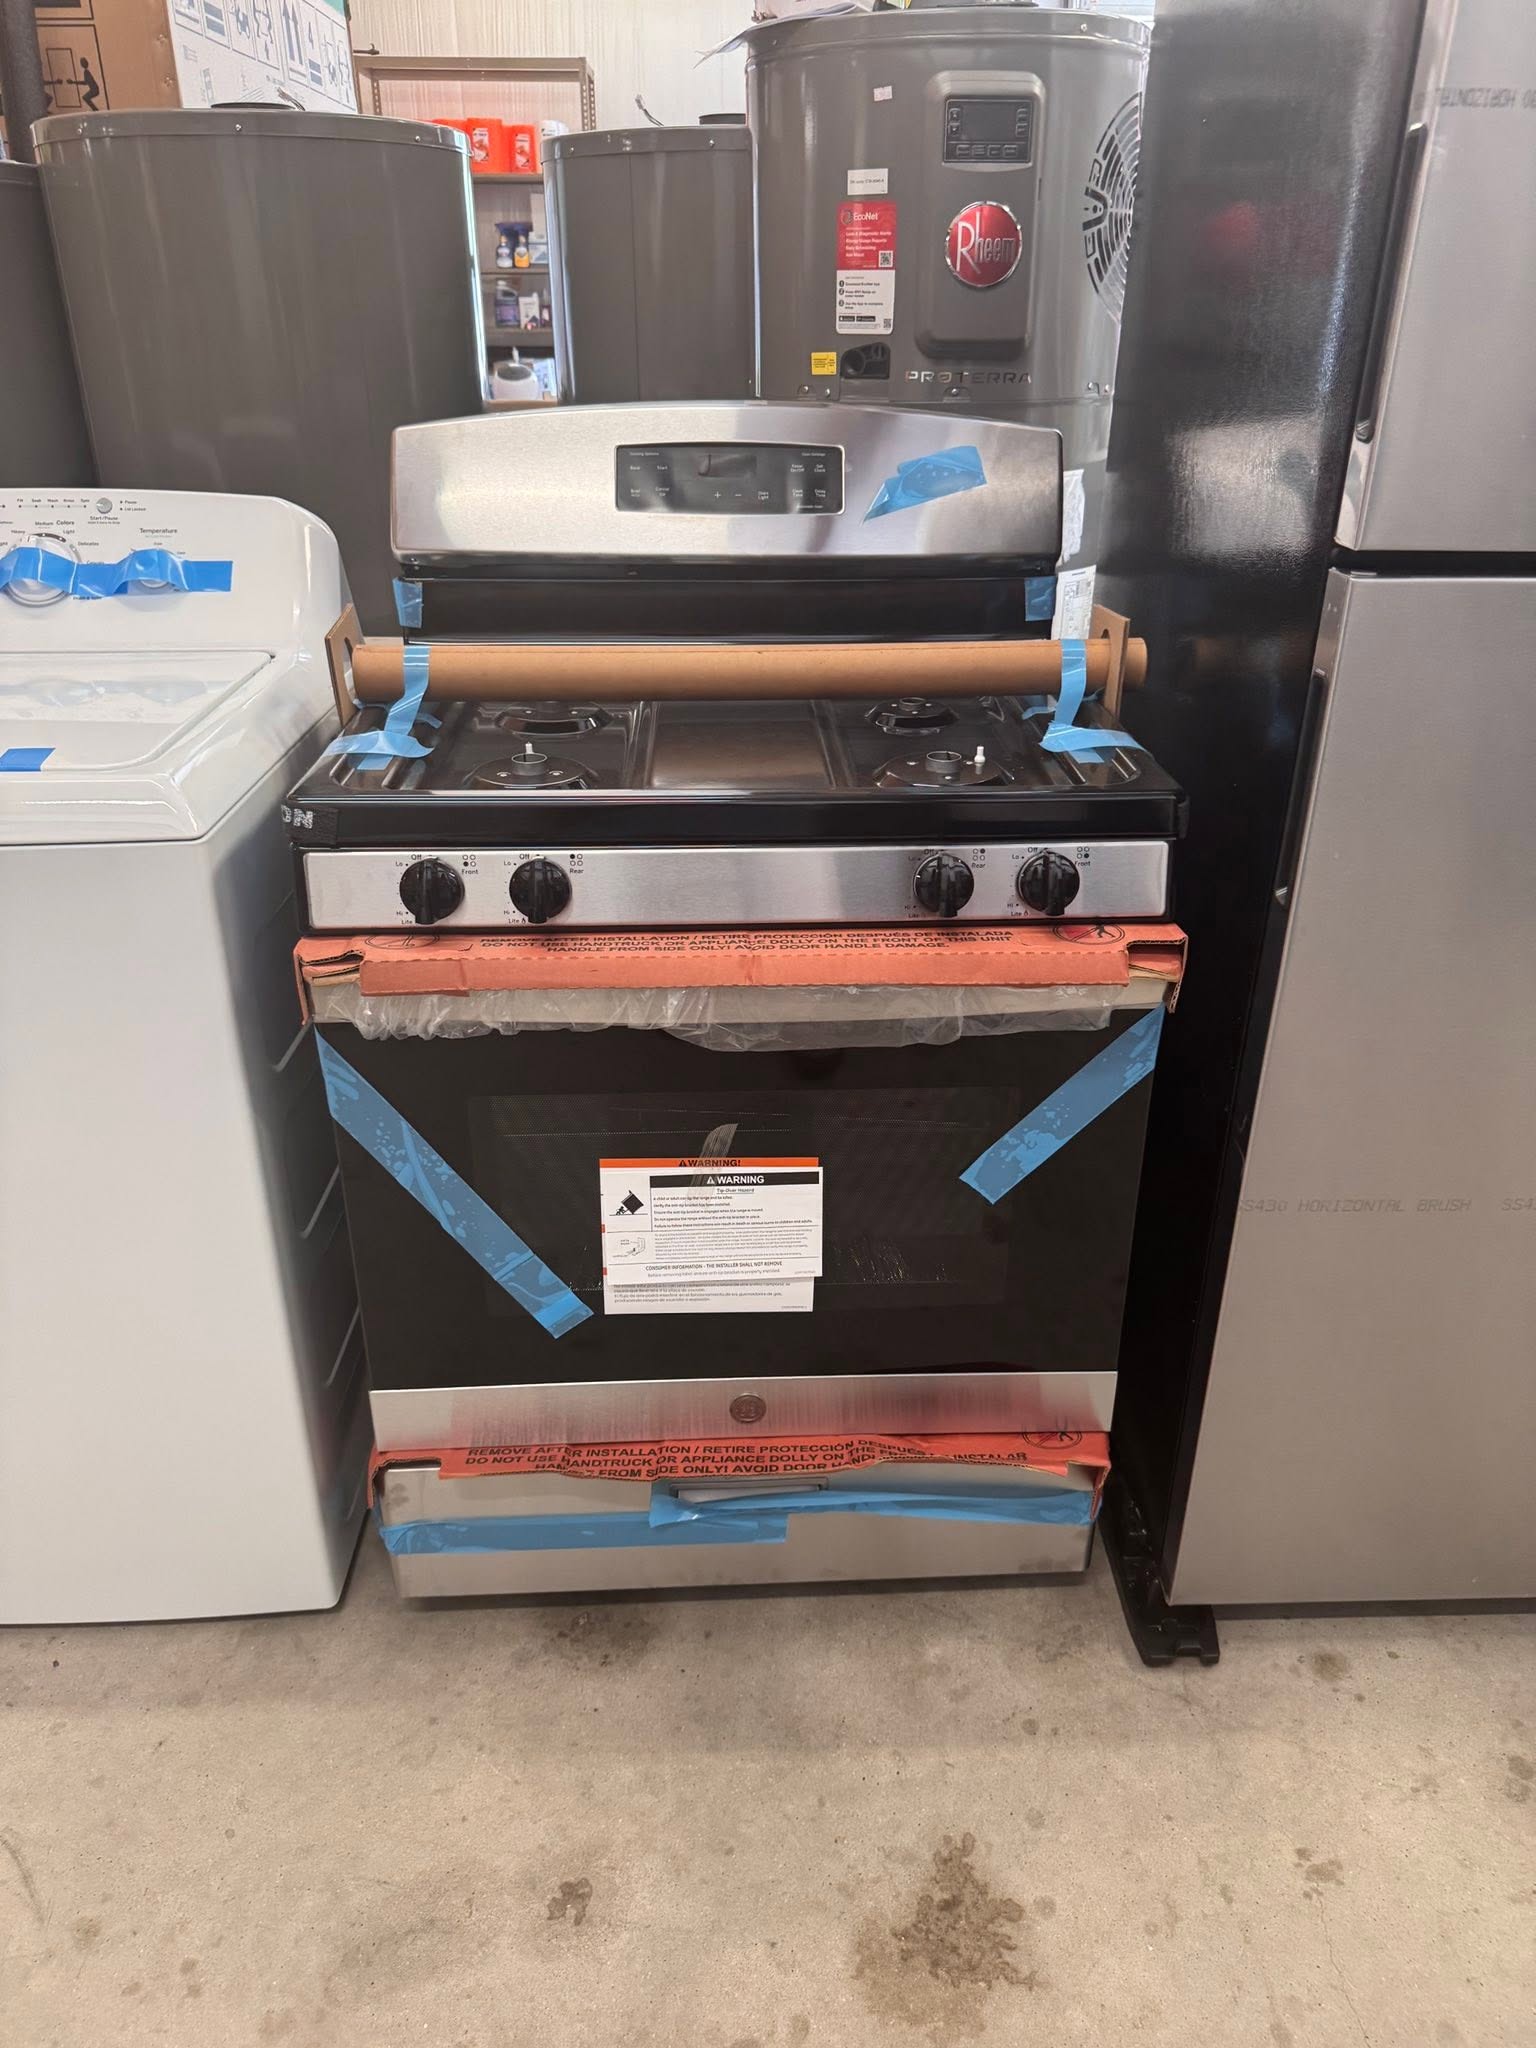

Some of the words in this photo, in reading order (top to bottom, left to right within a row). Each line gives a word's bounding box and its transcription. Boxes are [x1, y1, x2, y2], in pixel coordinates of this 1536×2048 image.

[853, 212, 878, 221] EcoNet
[957, 211, 1016, 274] Rheem
[906, 371, 1032, 384] PROTERRA
[688, 1159, 741, 1167] WARNING!
[717, 1175, 765, 1184] WARNING
[1297, 1199, 1406, 1213] HORIZONTAL
[1416, 1199, 1471, 1213] BRUSH
[468, 1447, 531, 1456] REMOVE
[535, 1446, 582, 1457] AFTER
[586, 1446, 690, 1457] INSTALLATION
[759, 1440, 854, 1454] PROTECCIÓN
[465, 1457, 488, 1465] DO
[491, 1456, 522, 1464] NOT
[527, 1455, 558, 1463] USE
[560, 1455, 654, 1468] HANDTRUCK
[656, 1456, 677, 1465] OR
[681, 1455, 765, 1463] APPLIANCE
[769, 1454, 818, 1462] DOLLY
[848, 1446, 875, 1457] THE
[599, 1469, 641, 1478] FROM
[646, 1465, 678, 1477] SIDE
[683, 1465, 728, 1474] ONLY!
[732, 1465, 779, 1473] AVOID
[783, 1463, 827, 1471] DOOR
